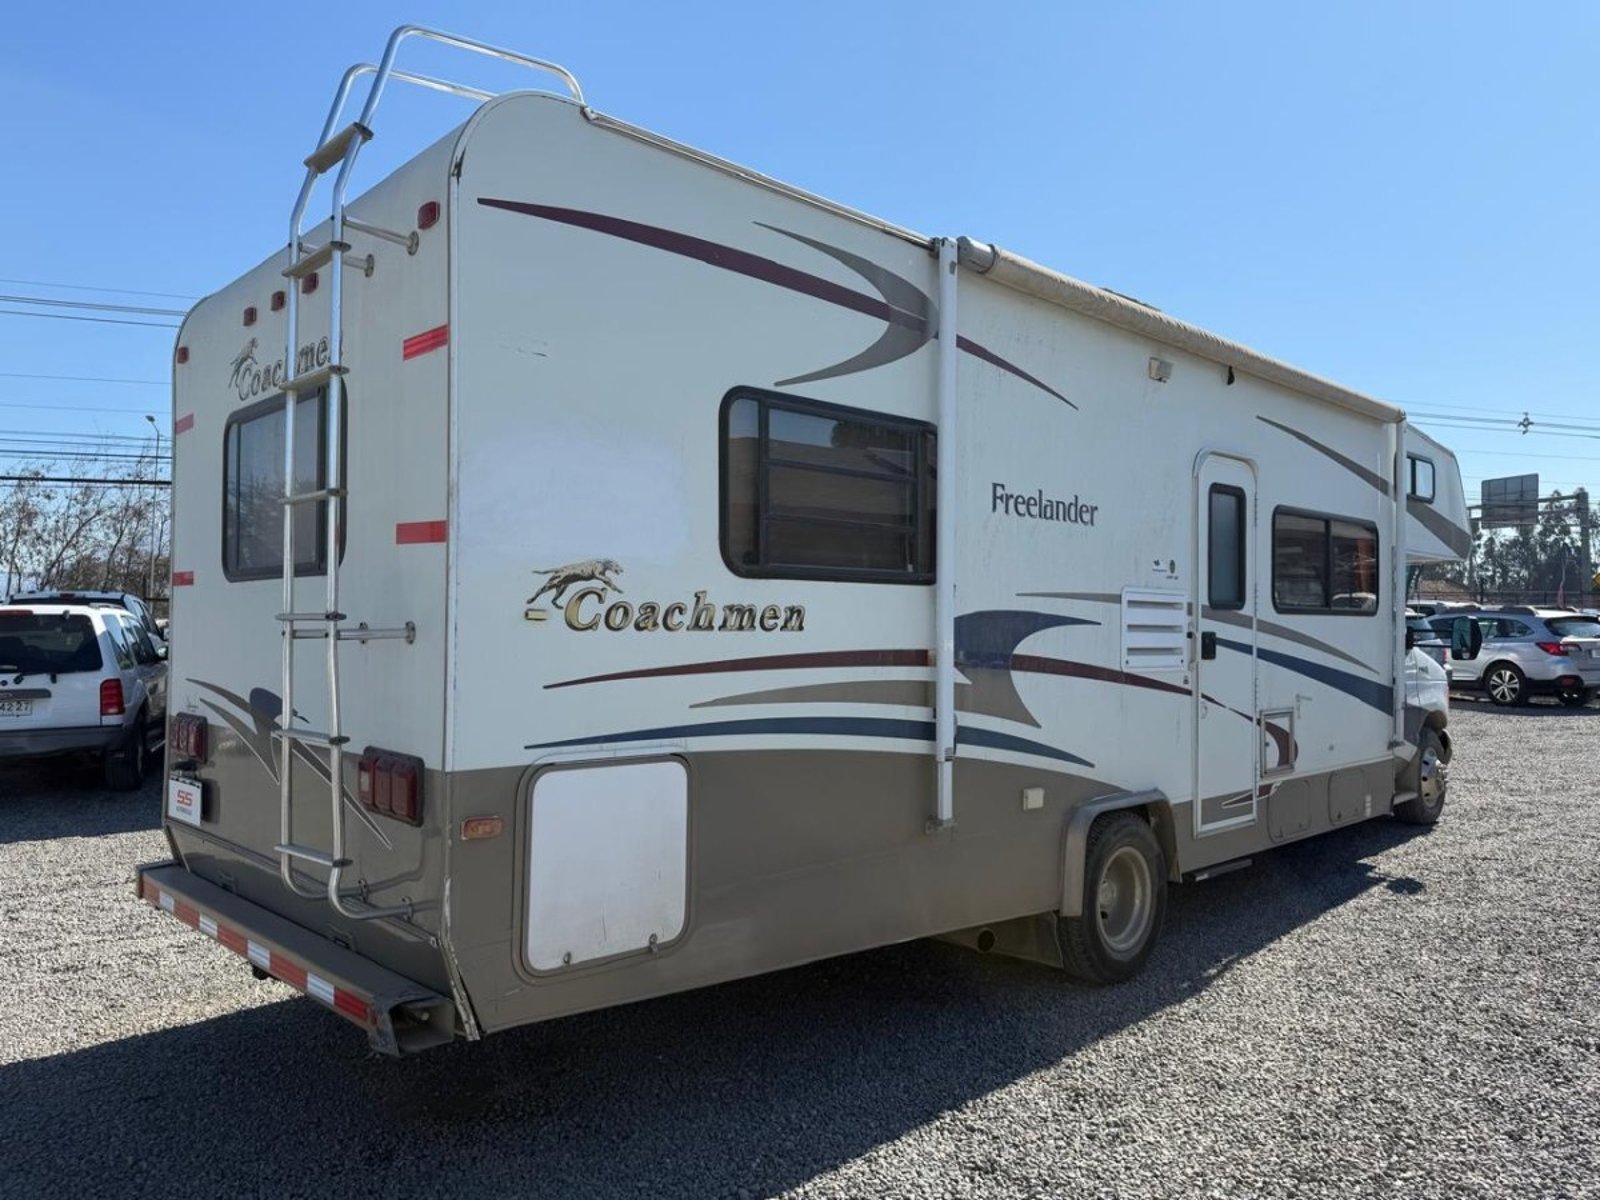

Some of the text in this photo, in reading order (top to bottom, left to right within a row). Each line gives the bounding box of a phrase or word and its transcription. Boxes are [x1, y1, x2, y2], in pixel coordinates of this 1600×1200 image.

[236, 335, 342, 401] Coacme
[992, 482, 1098, 526] Freelander
[564, 586, 806, 632] Coachmen
